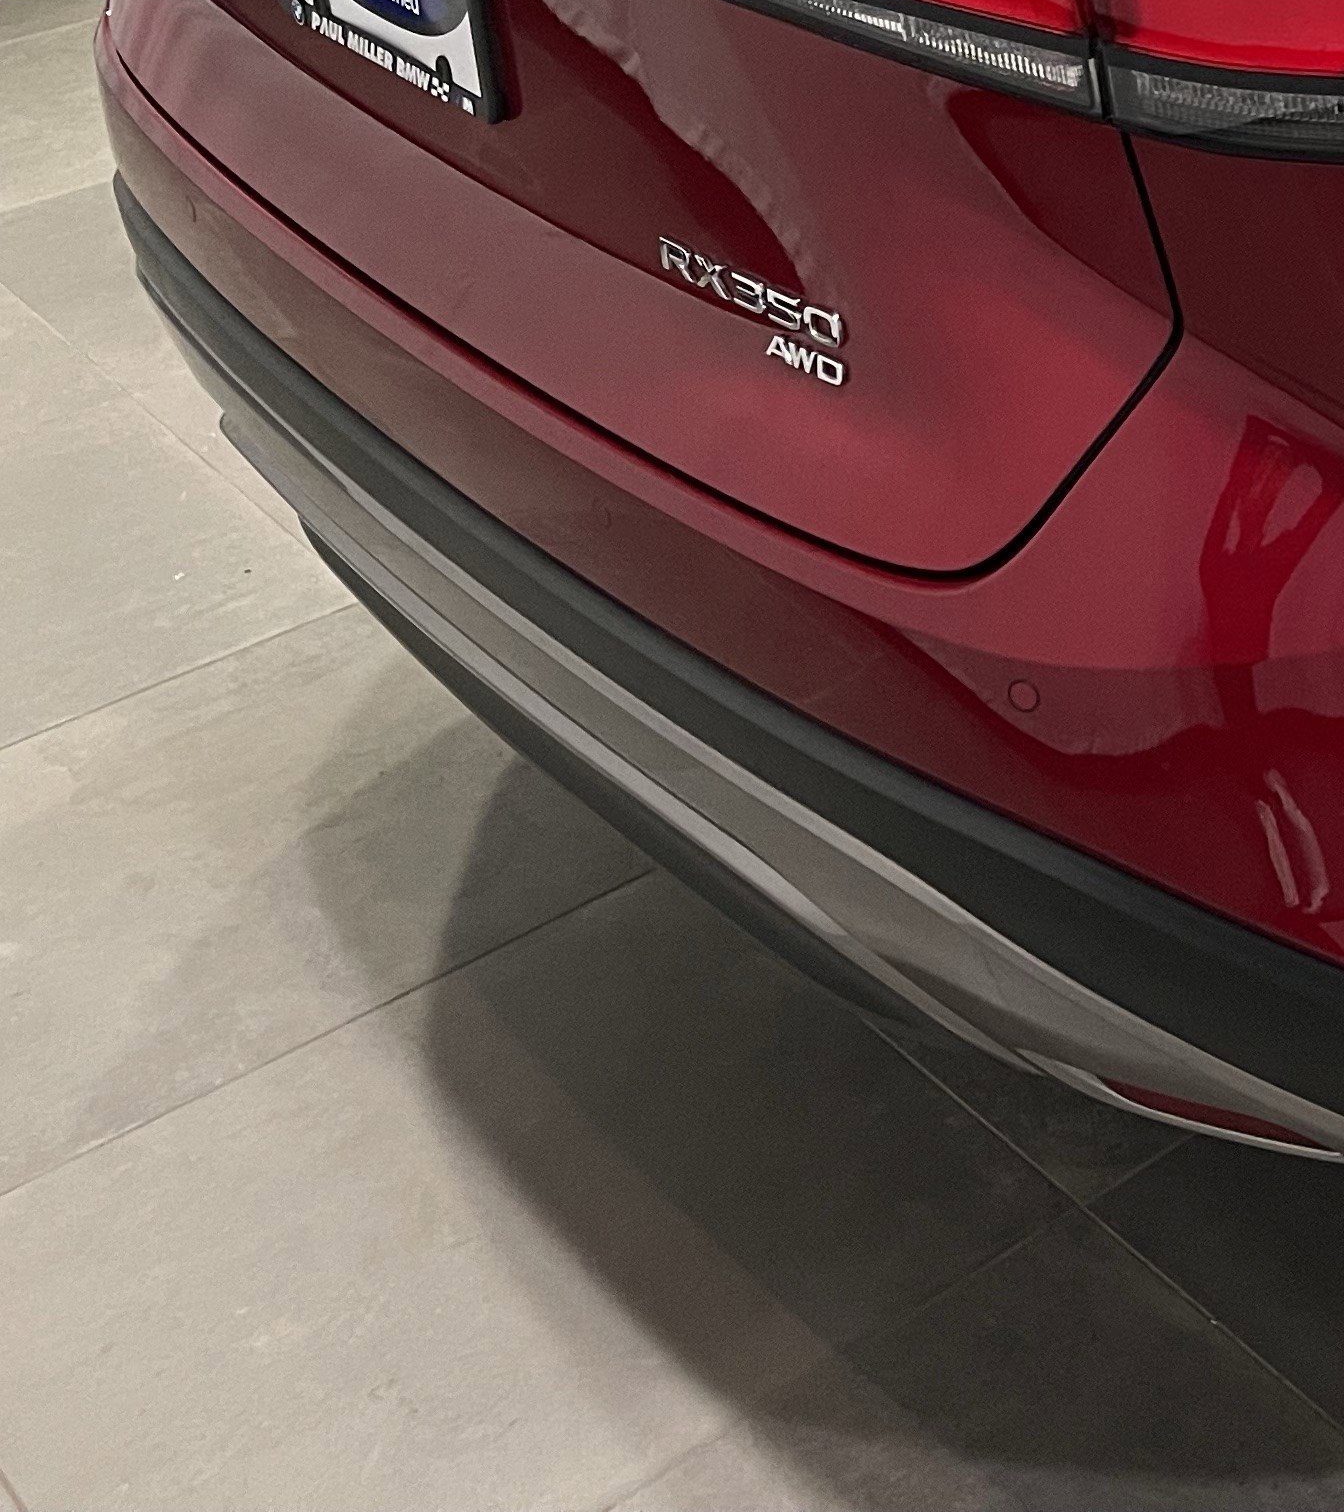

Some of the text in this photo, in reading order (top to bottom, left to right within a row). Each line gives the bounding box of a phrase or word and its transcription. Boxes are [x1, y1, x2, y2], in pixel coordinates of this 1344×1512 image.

[311, 12, 431, 91] PAUL MILLER BMW
[766, 335, 844, 387] AWD
